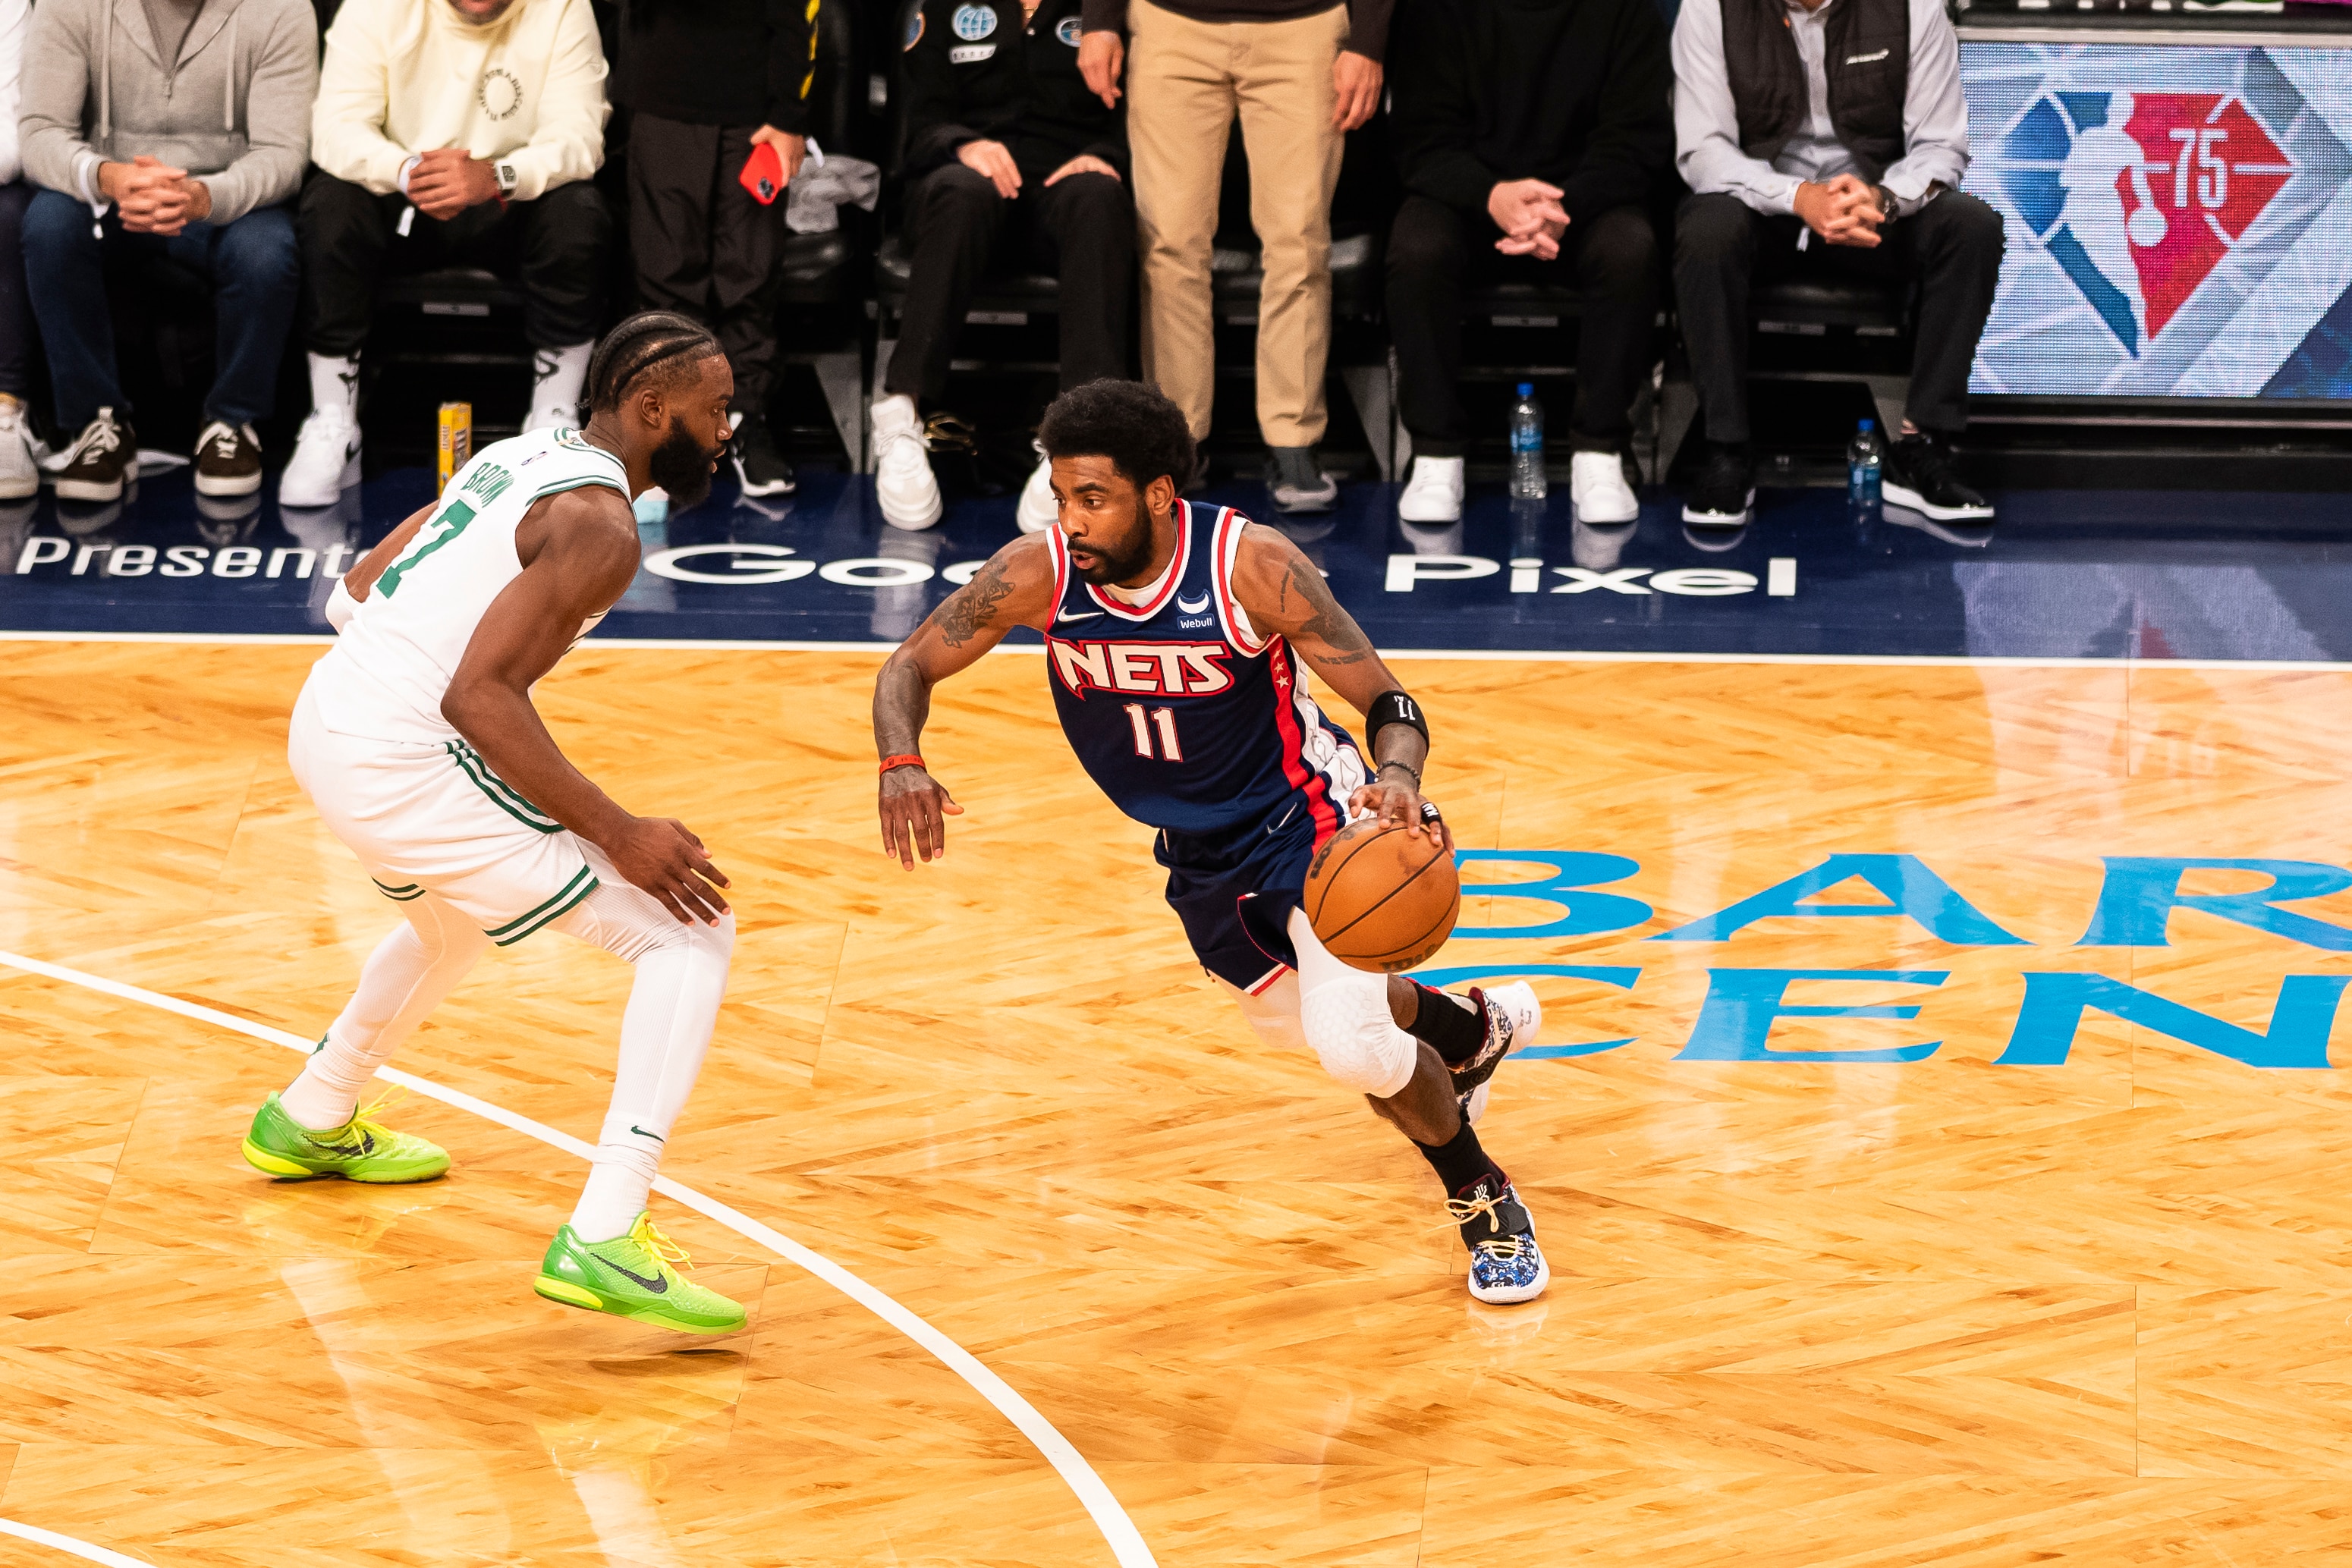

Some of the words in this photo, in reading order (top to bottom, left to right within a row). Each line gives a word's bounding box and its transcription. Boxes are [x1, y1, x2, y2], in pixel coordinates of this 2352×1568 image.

[2168, 127, 2228, 209] 75
[15, 536, 373, 580] Present
[1385, 554, 1797, 596] Pixel
[376, 498, 478, 599] 7
[1180, 617, 1213, 629] Webull
[1047, 640, 1234, 699] NETS
[1123, 703, 1184, 762] 11
